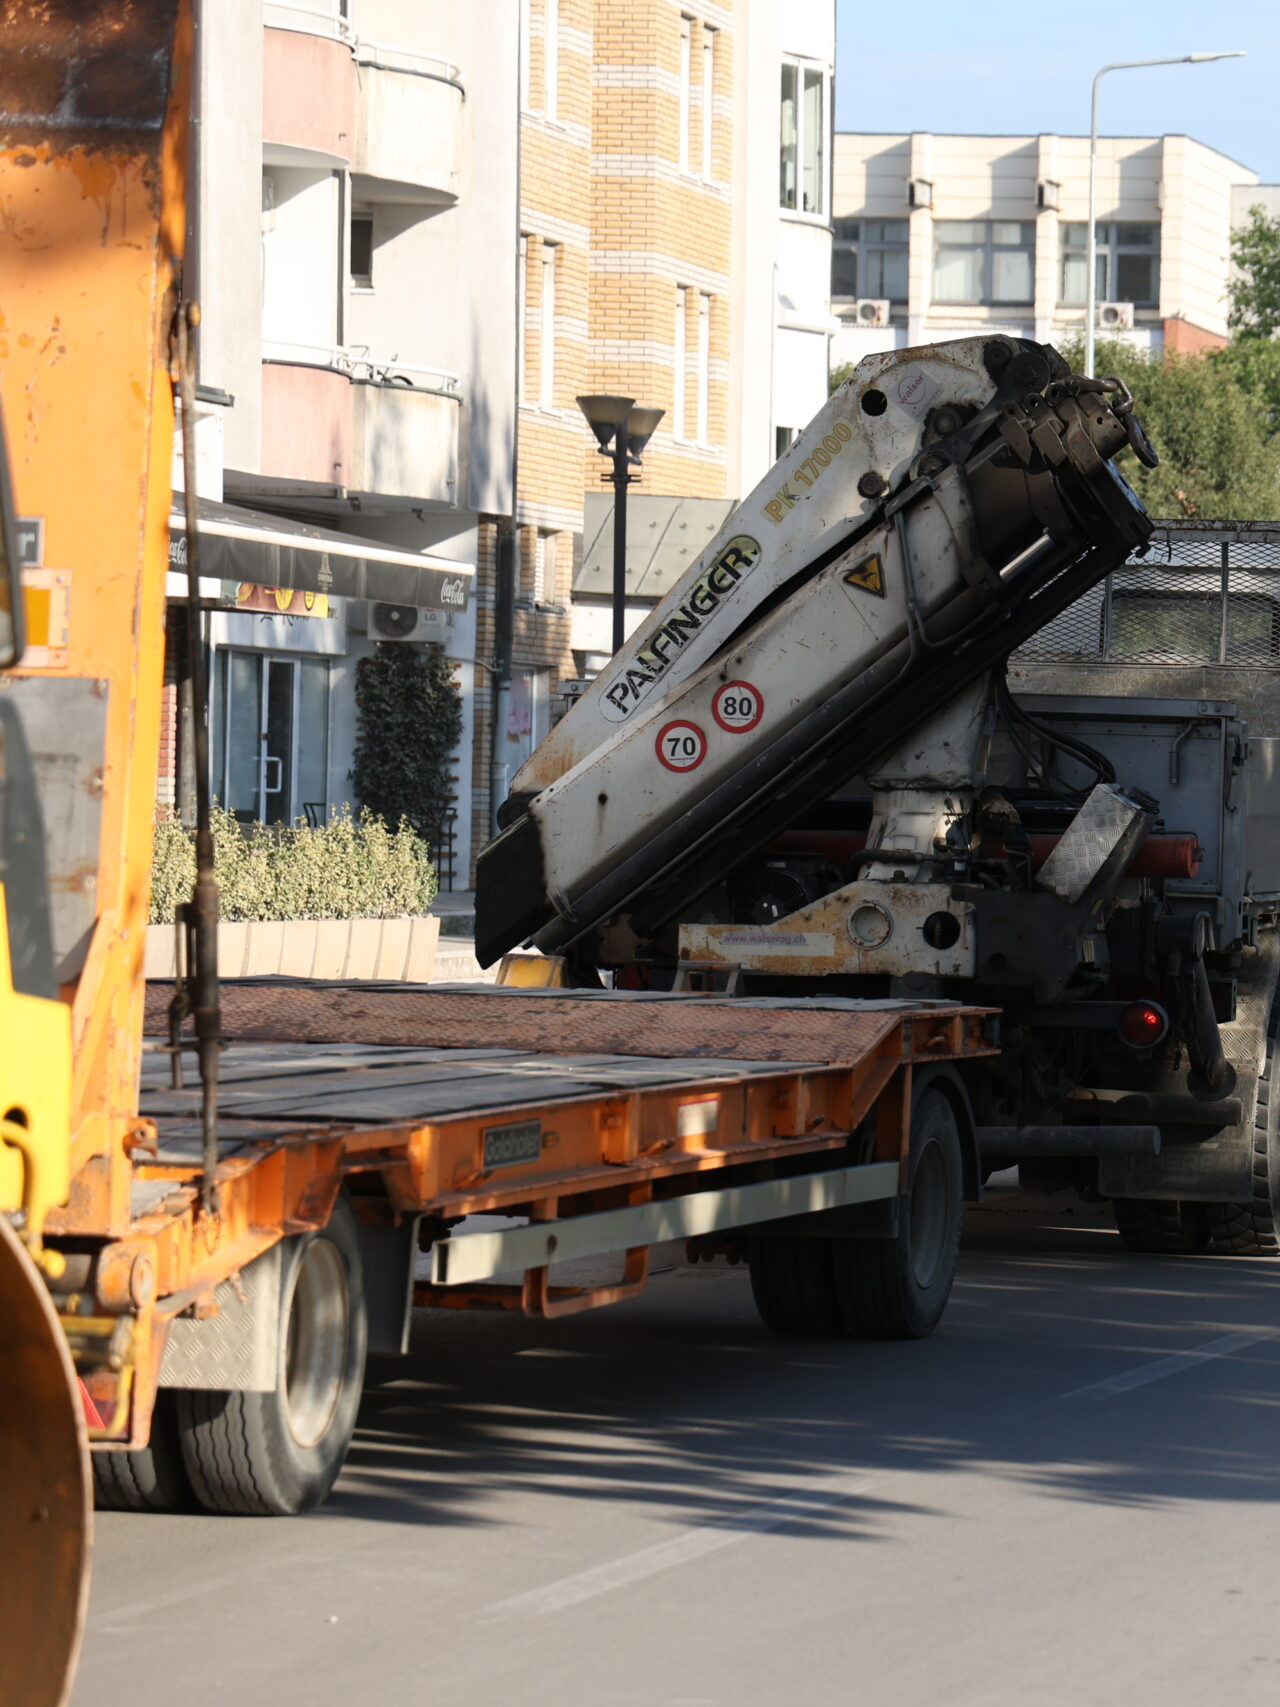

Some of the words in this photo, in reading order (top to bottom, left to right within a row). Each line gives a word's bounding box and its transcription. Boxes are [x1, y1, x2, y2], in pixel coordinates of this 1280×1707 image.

[764, 482, 797, 522] PK
[794, 422, 853, 487] 17000
[424, 612, 437, 621] LG
[605, 547, 754, 715] PALFINGER
[723, 696, 752, 717] 80
[667, 736, 696, 757] 70
